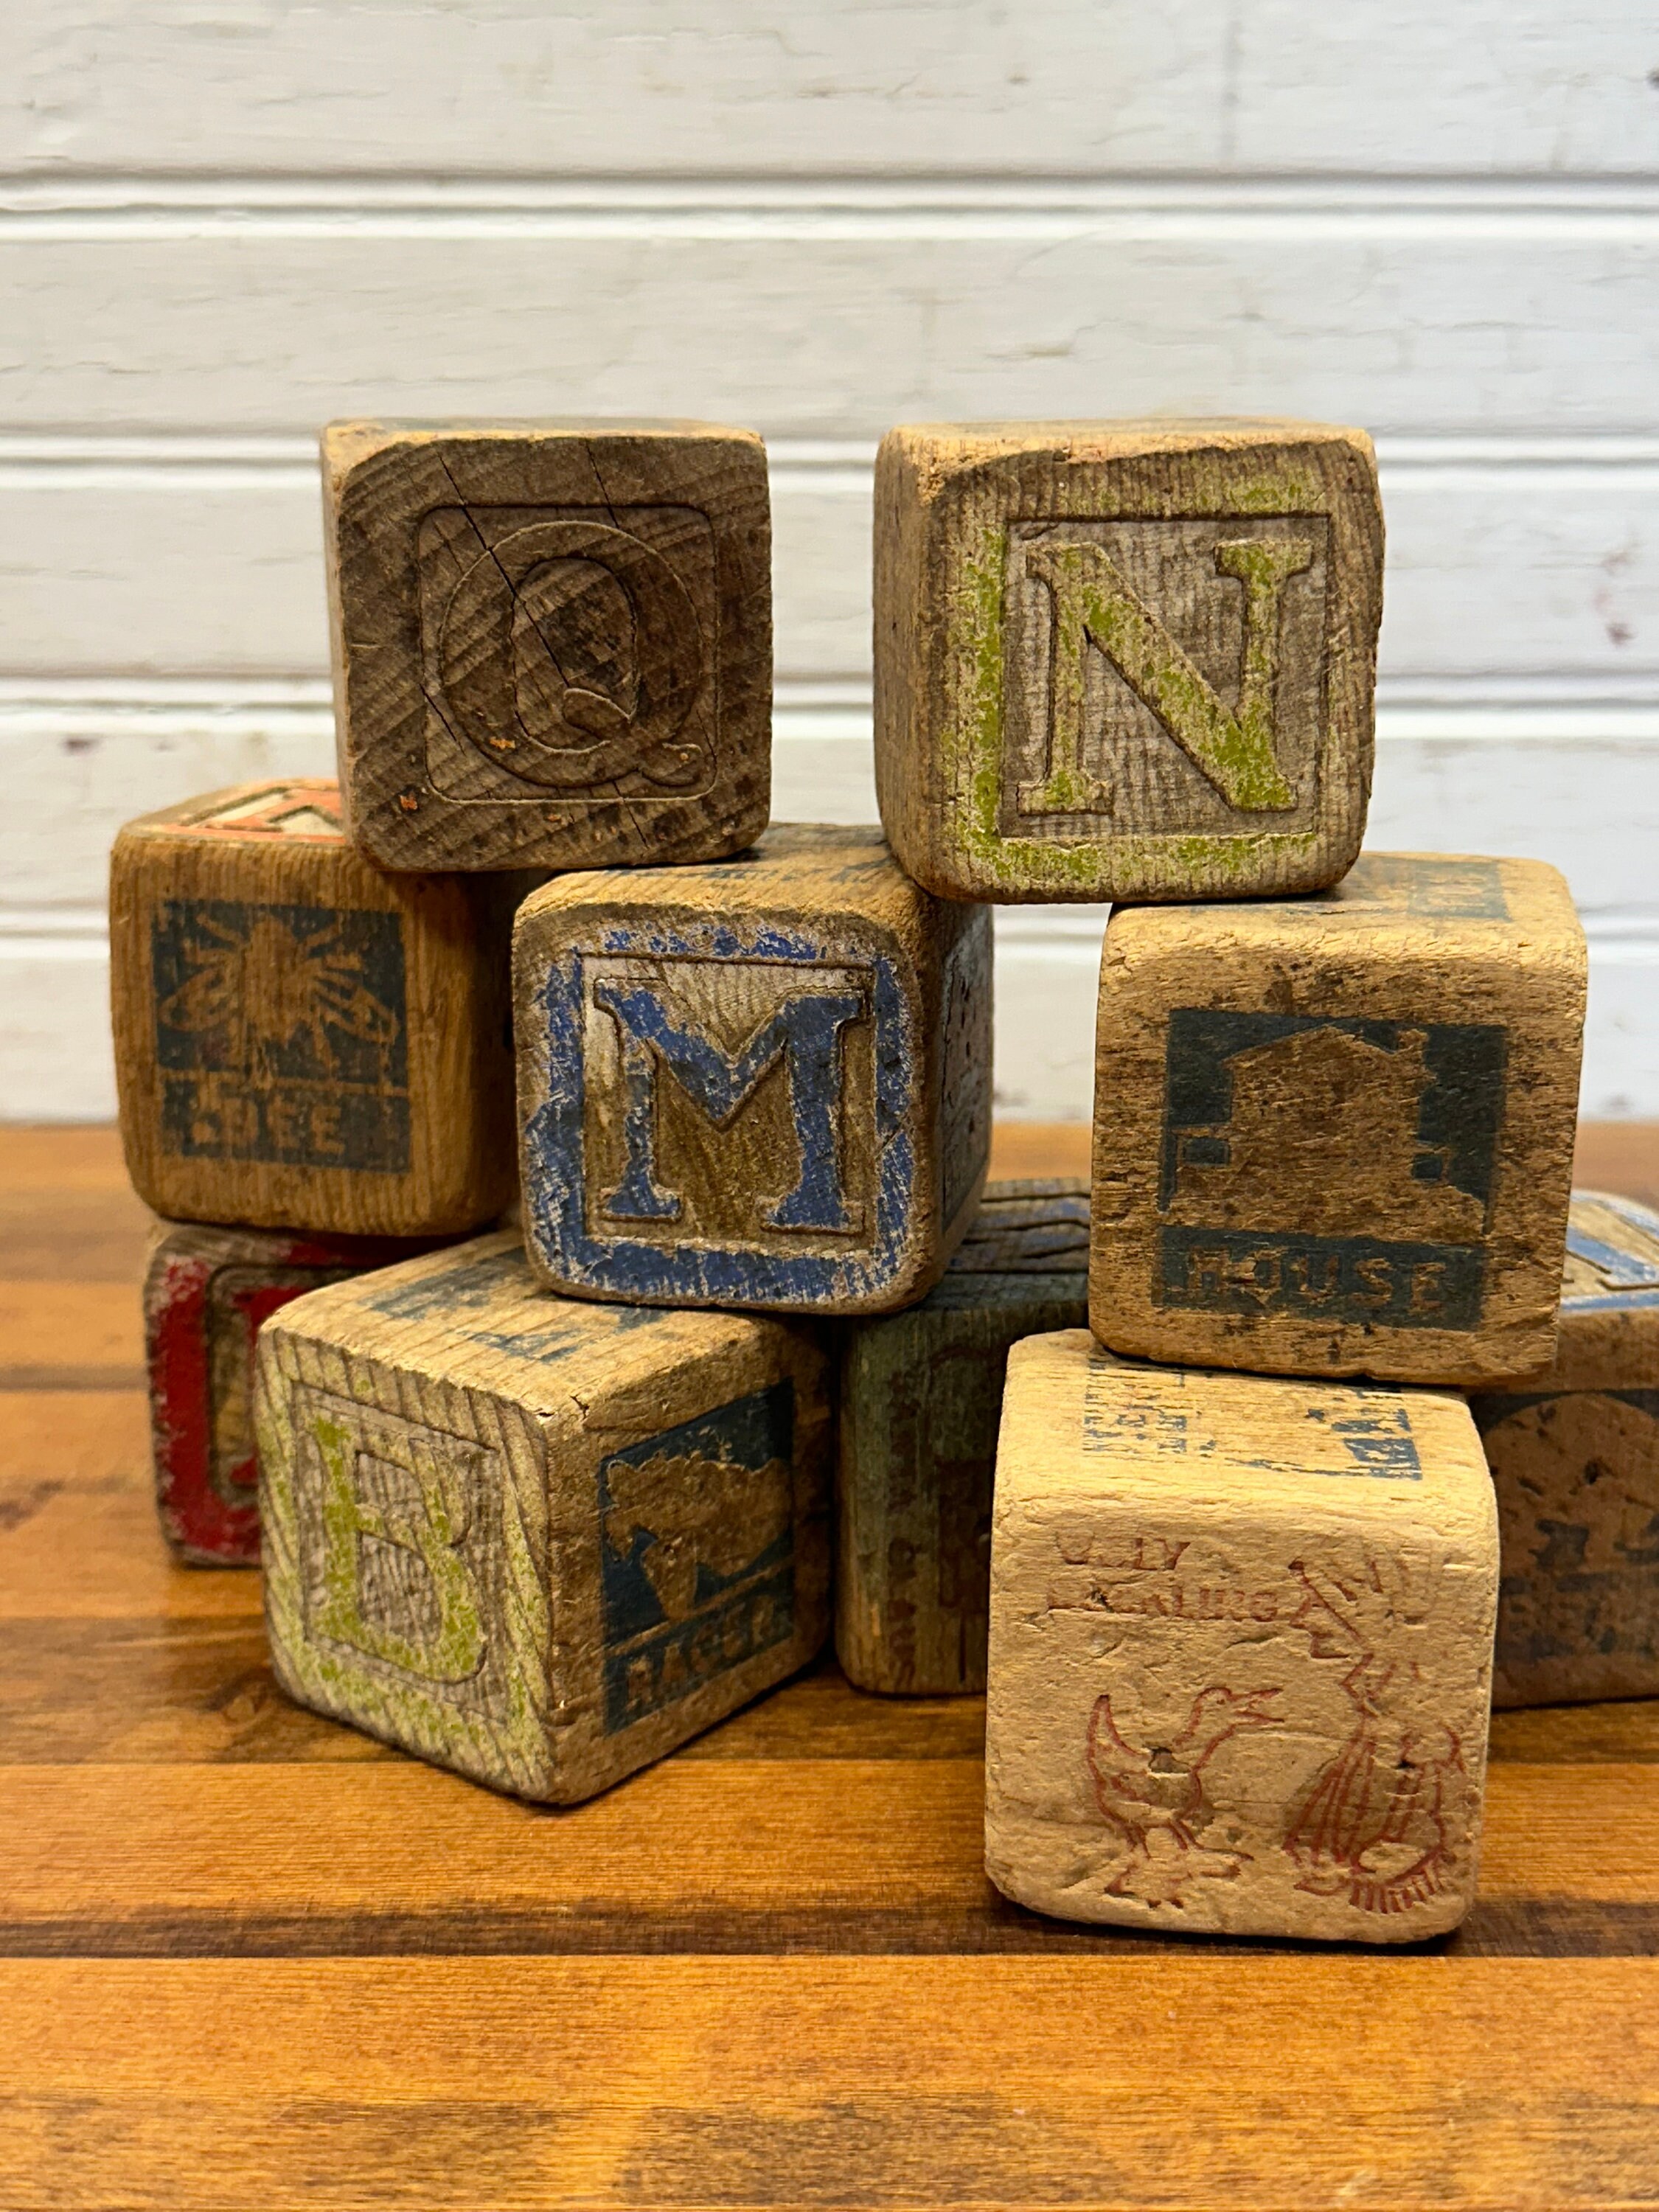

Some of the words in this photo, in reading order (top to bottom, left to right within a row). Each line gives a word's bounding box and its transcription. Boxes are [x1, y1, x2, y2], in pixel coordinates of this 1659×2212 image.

[439, 519, 704, 790] Q
[1016, 538, 1313, 816] N
[593, 978, 872, 1236] M
[1188, 1245, 1447, 1315] HOUSE
[302, 1402, 488, 1686] B
